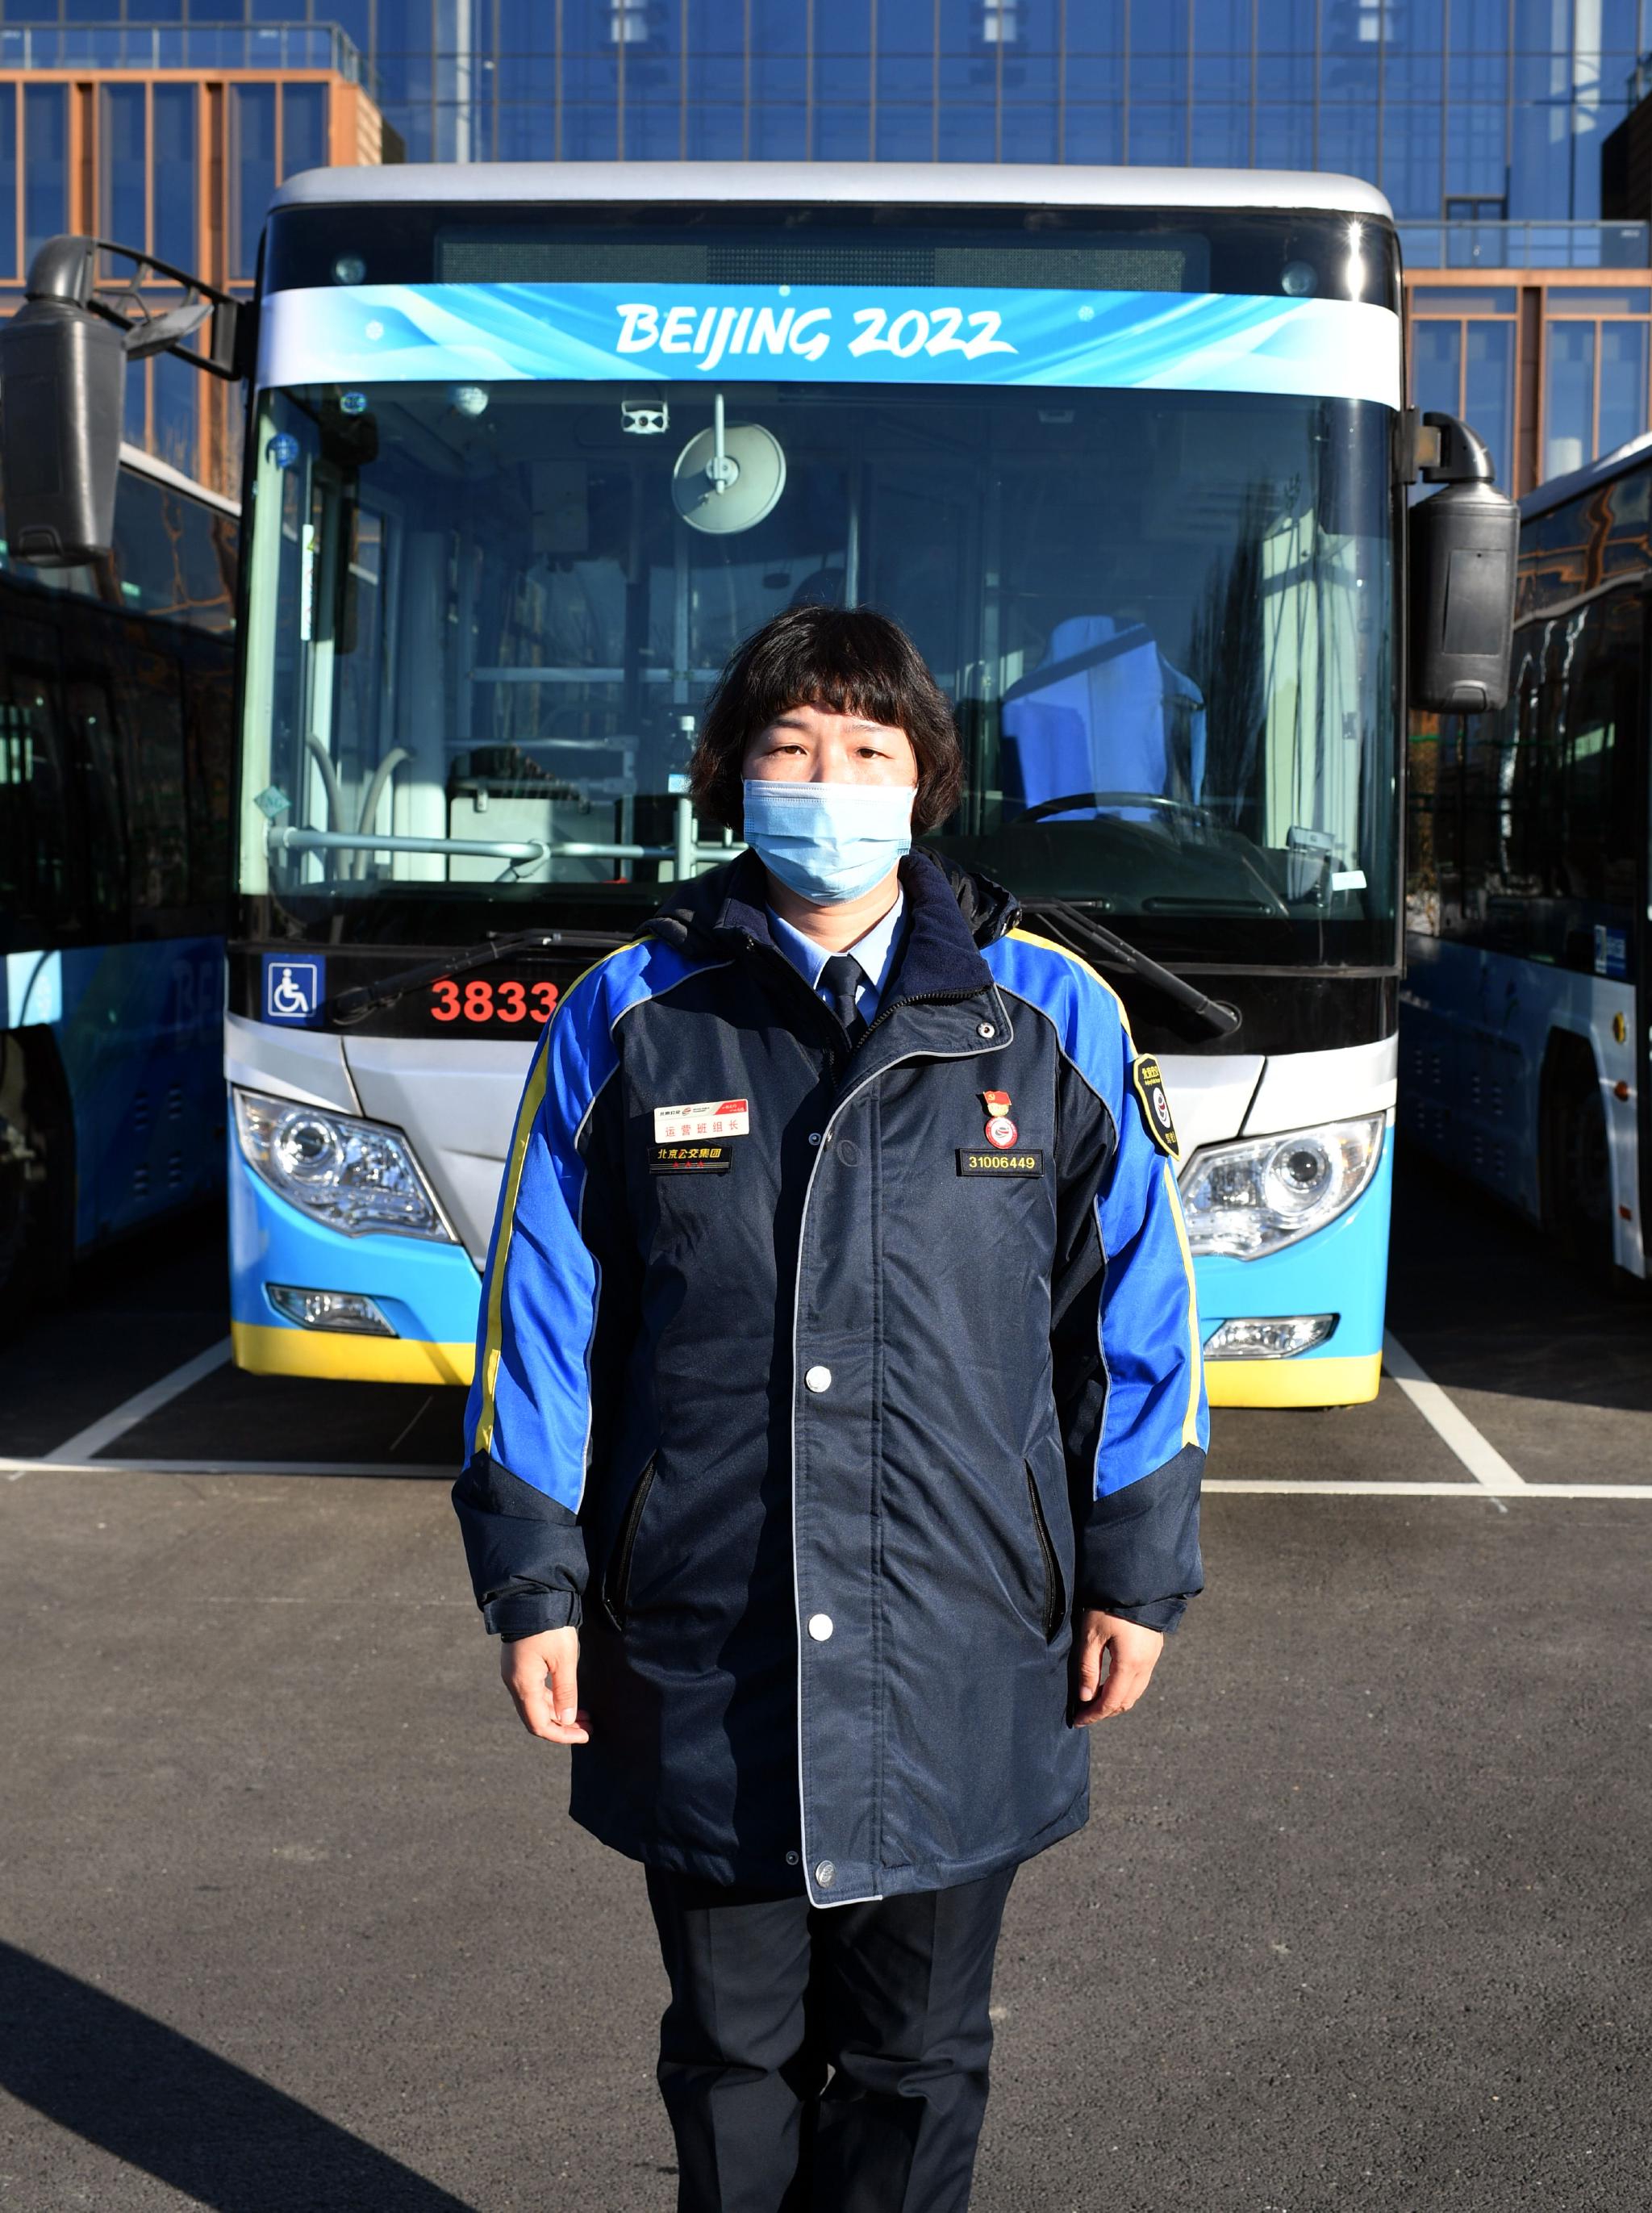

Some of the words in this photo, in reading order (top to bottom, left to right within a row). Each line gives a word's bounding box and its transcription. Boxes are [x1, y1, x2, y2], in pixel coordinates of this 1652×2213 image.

[616, 303, 832, 371] BEIJING
[848, 307, 1020, 361] 2022
[431, 980, 558, 1023] 3833
[665, 1119, 739, 1138] 运营班组长
[657, 1148, 722, 1159] 北京公交集团
[969, 1156, 1035, 1169] 31006449
